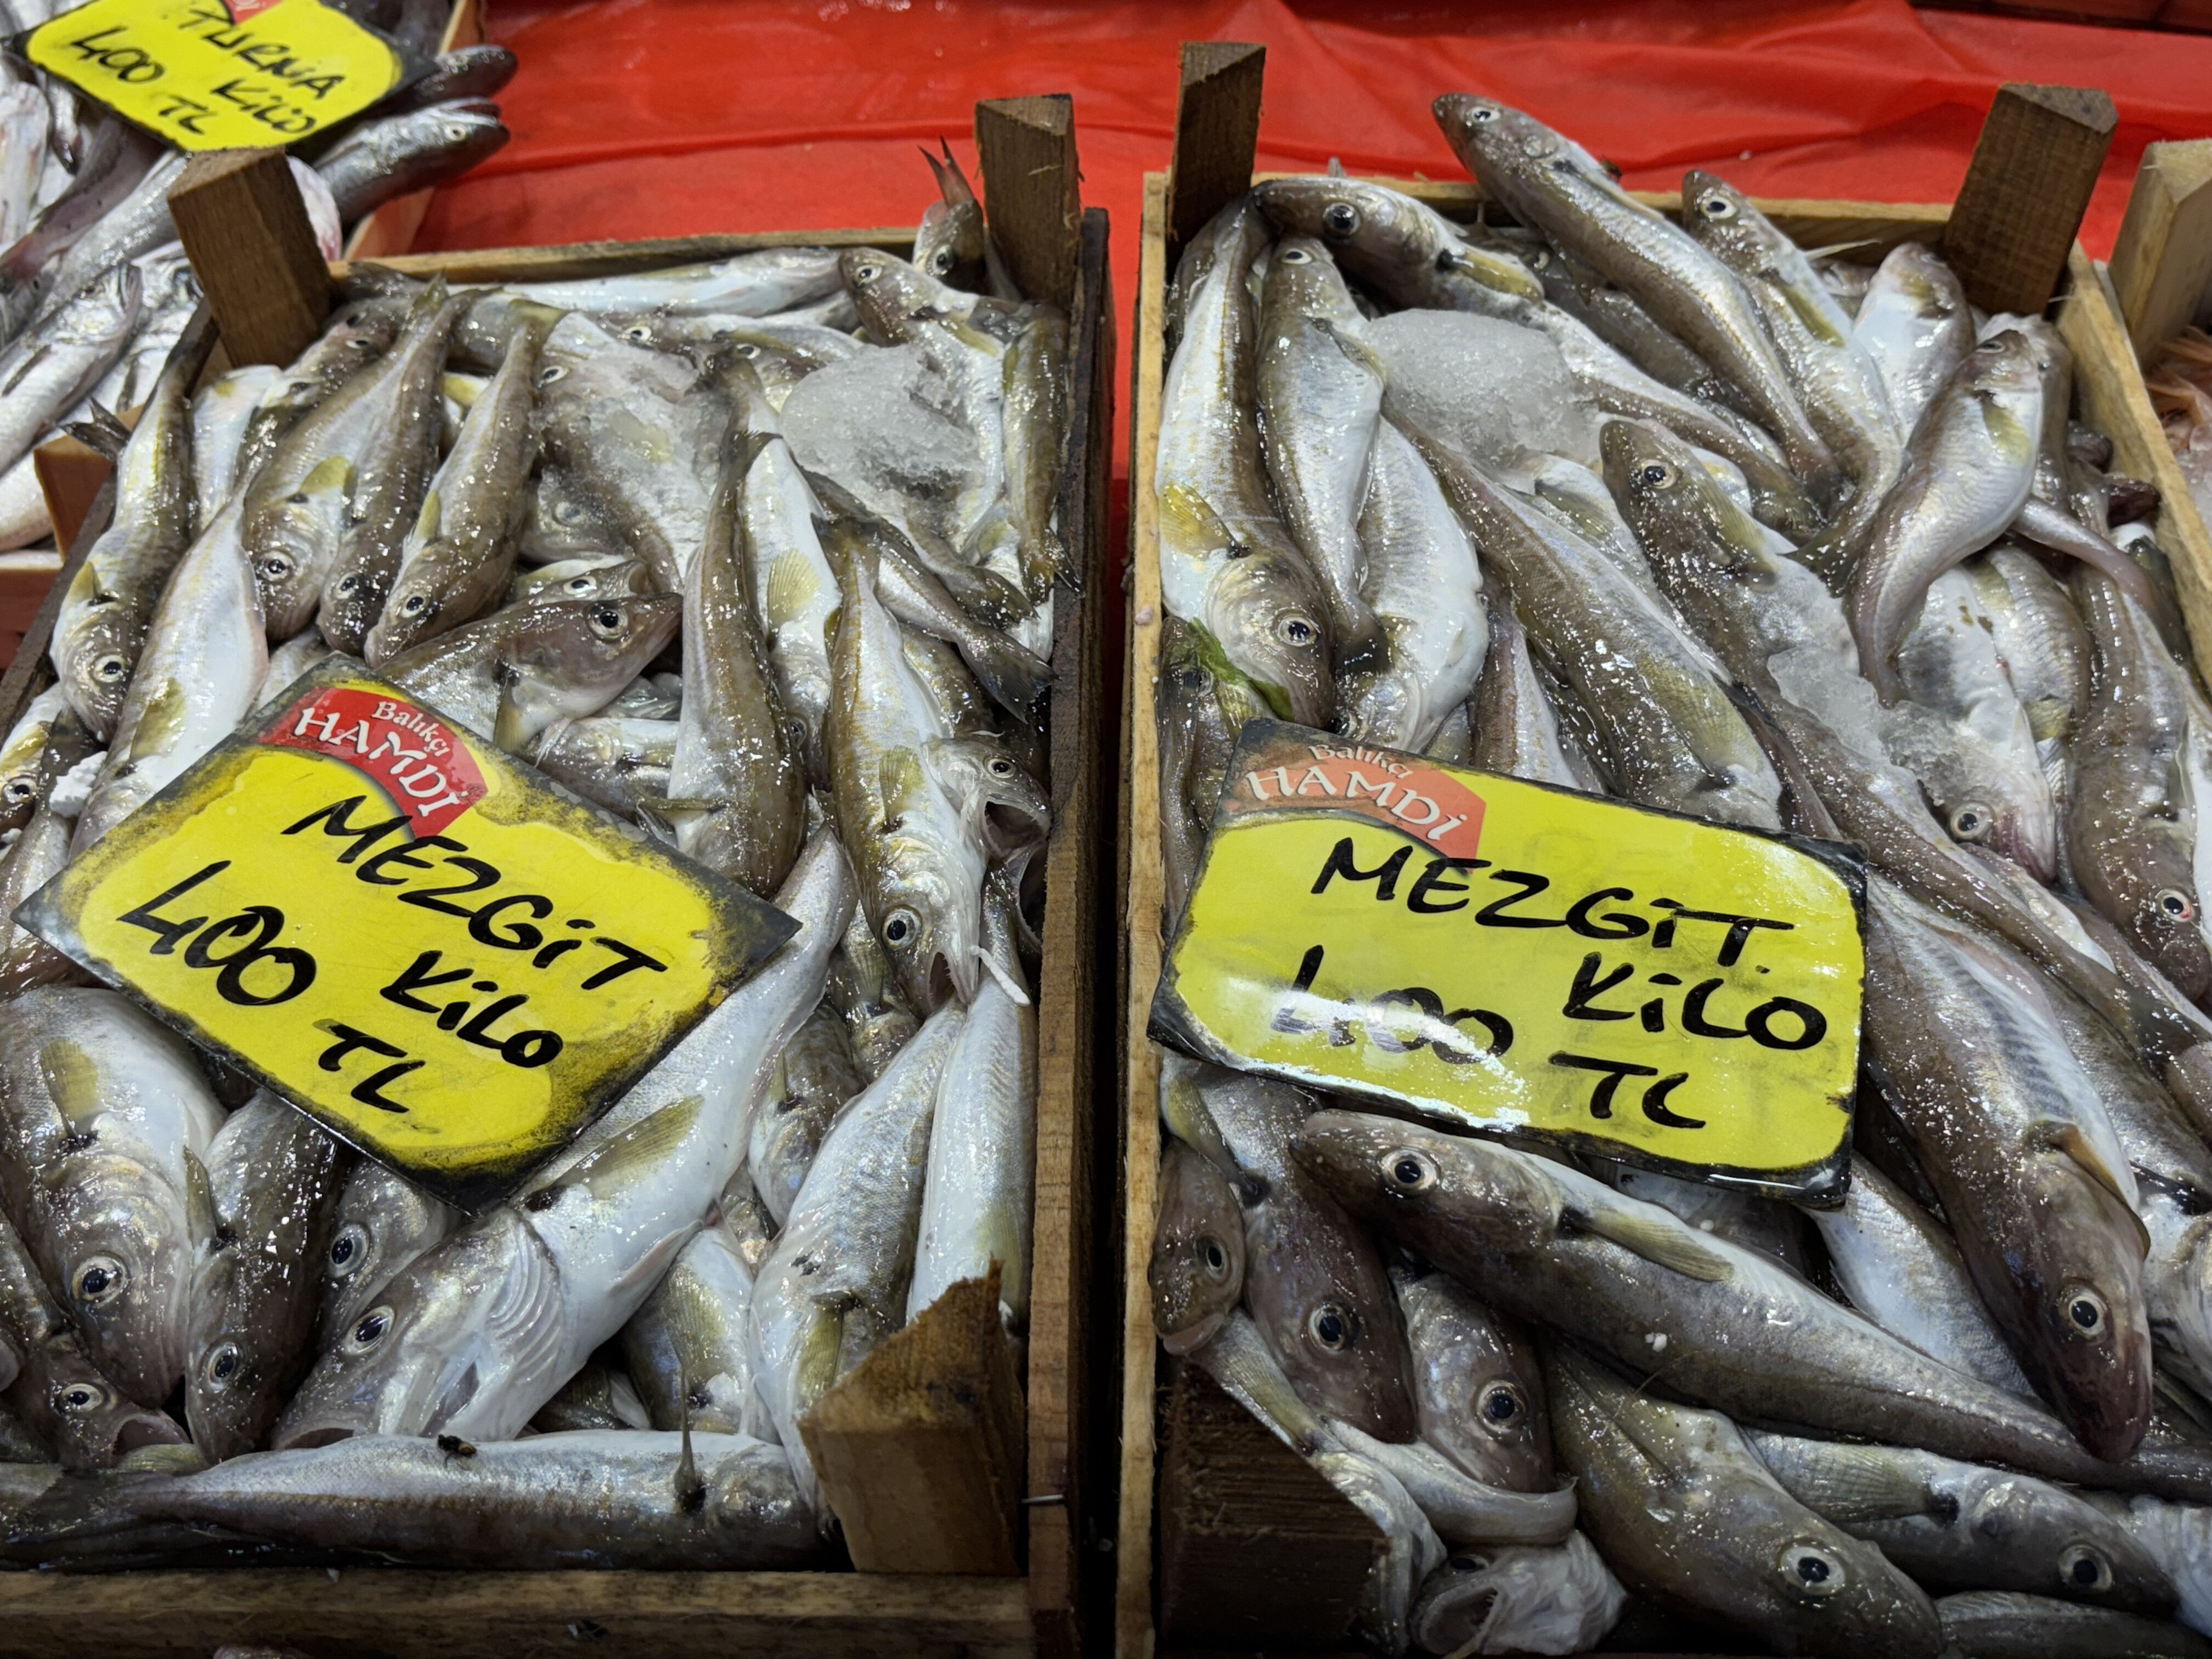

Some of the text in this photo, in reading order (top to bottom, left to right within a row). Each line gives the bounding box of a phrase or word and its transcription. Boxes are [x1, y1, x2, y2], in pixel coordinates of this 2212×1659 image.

[71, 26, 165, 84] 400
[158, 95, 218, 136] TL
[371, 701, 450, 757] Balıkçı
[1308, 744, 1413, 780] Balıkçı
[116, 859, 317, 1006] 400
[1271, 945, 1515, 1065] 400
[312, 1020, 426, 1113] TL
